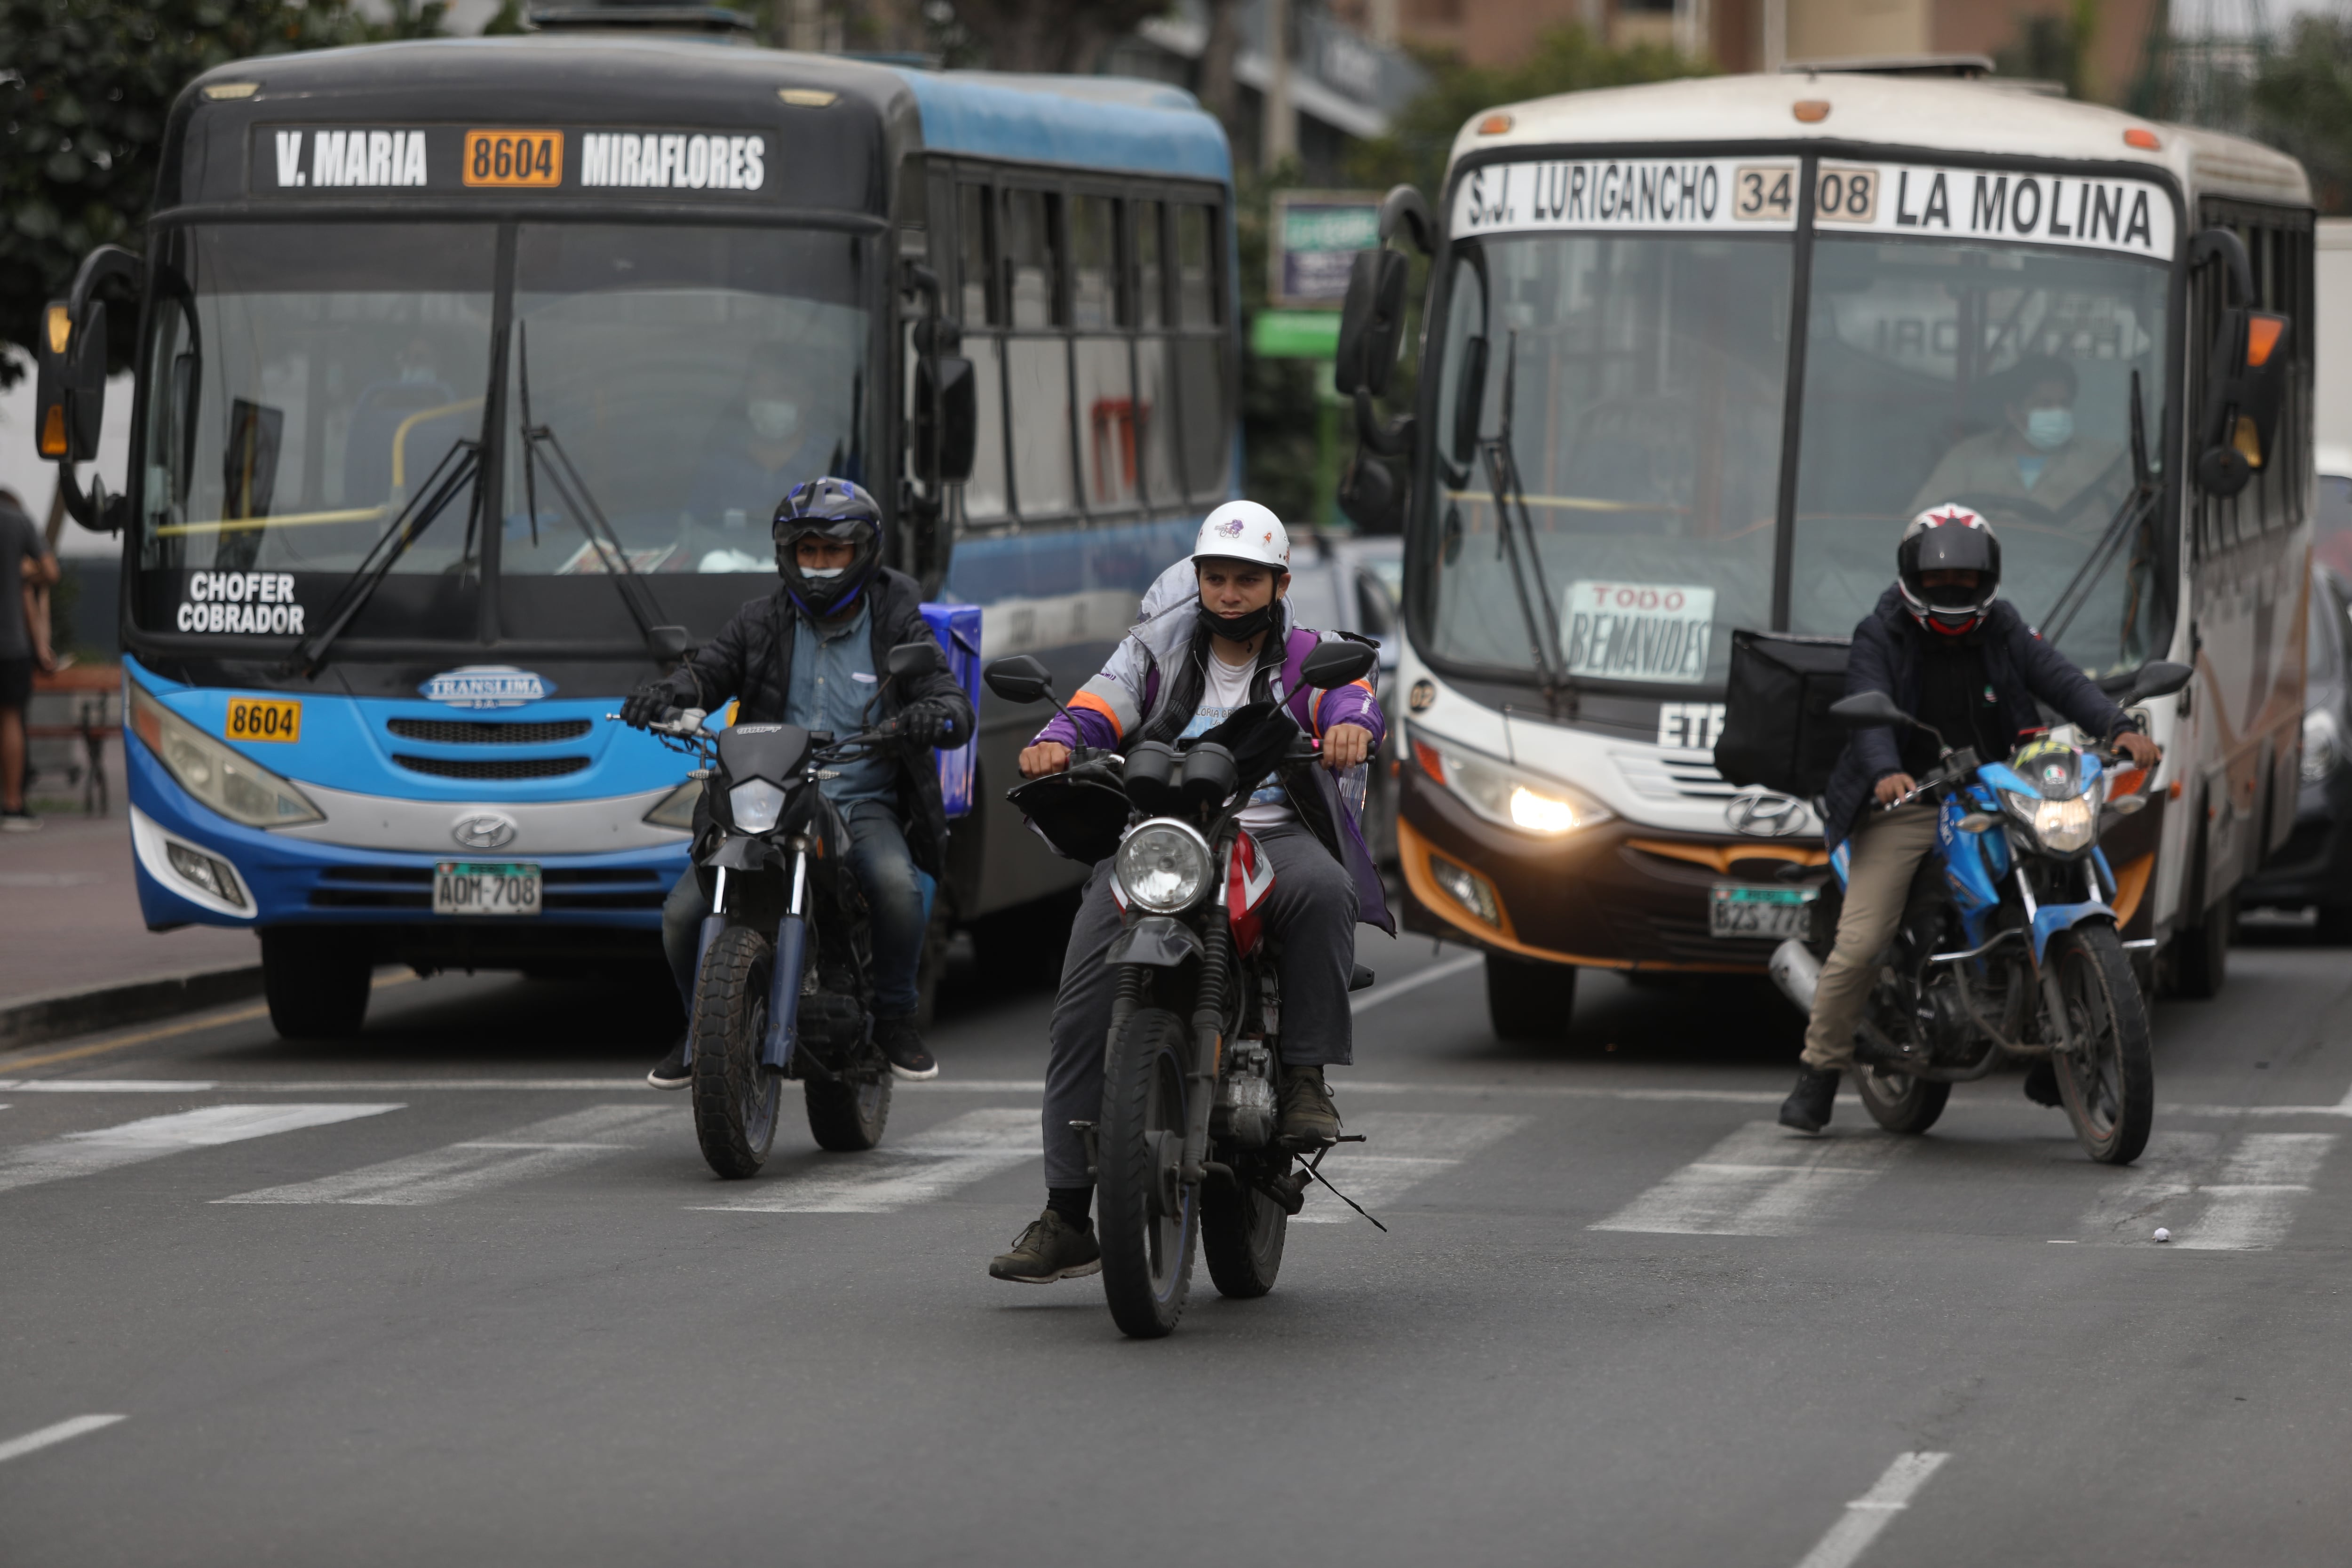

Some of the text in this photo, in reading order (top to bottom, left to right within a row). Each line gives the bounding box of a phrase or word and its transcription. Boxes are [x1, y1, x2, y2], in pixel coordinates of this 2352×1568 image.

[276, 130, 427, 187] V. MARIA
[472, 138, 553, 180] 8604
[581, 134, 765, 191] MIRAFLORES
[1468, 163, 1718, 226] S.J. LURIGANCHO
[1742, 173, 1869, 215] 34 08
[1895, 170, 2153, 249] LA MOLINA
[190, 571, 295, 603] CHOFER
[1592, 587, 1686, 612] TODO
[177, 602, 305, 635] COBRADOR
[1410, 685, 1434, 708] 02
[233, 705, 294, 736] 8604
